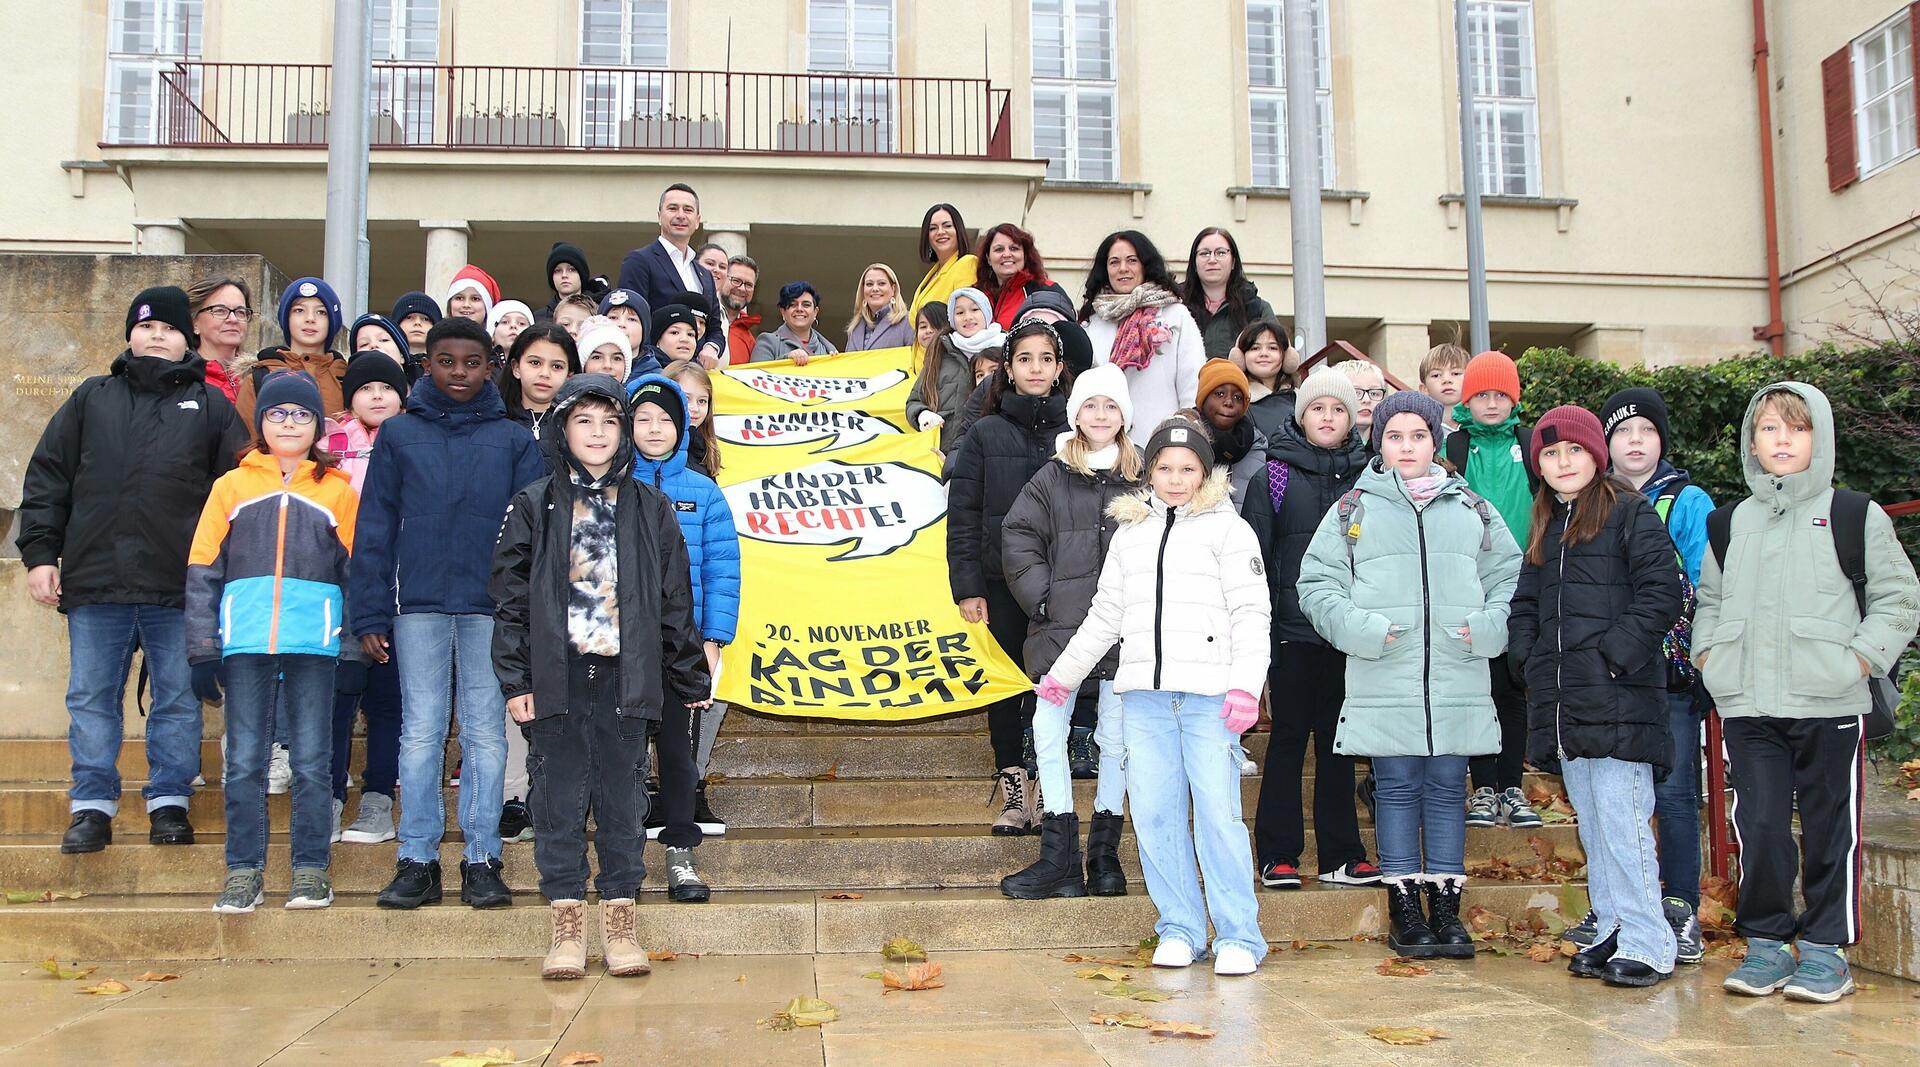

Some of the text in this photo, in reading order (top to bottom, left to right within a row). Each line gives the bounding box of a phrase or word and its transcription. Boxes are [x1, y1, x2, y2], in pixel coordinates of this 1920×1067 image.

[16, 375, 52, 384] MEINE
[16, 387, 56, 396] DURCH
[761, 466, 888, 491] KINDER
[748, 487, 864, 510] HABEN
[745, 501, 907, 535] RECHTE!
[764, 619, 932, 643] 20. NOVEMBER
[754, 632, 971, 672] AG DER
